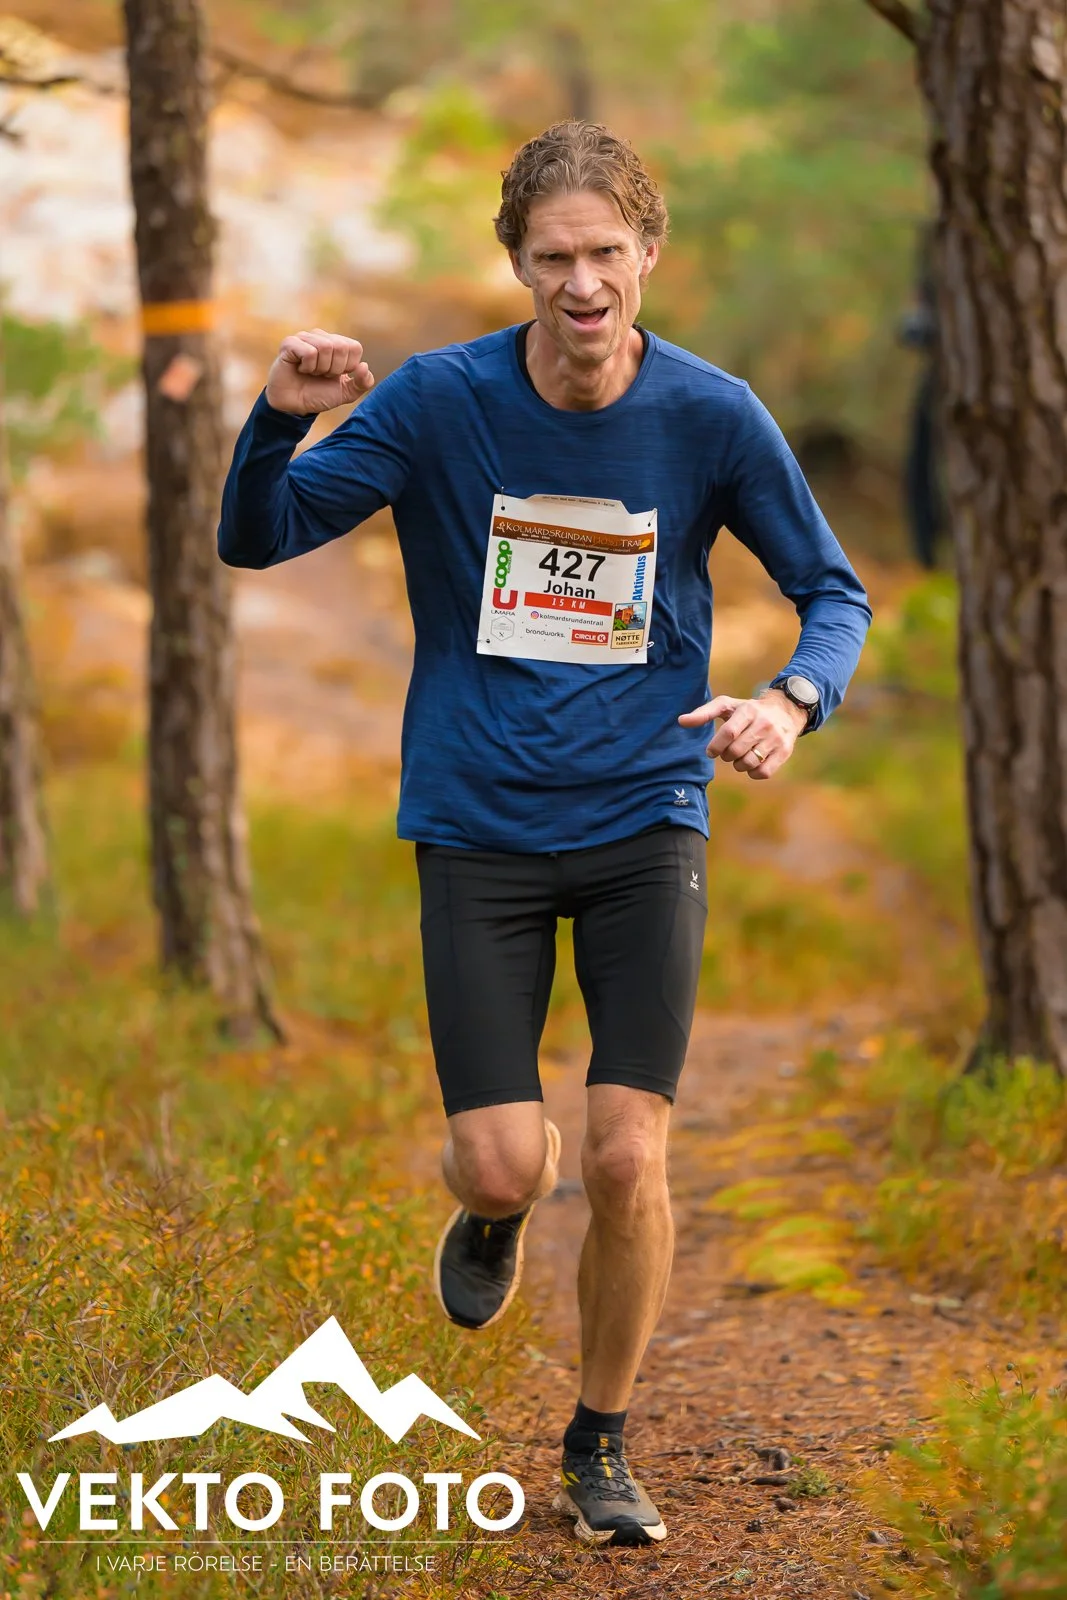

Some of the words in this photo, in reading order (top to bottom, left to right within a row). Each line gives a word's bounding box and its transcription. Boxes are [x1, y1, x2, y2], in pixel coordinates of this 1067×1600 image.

[495, 540, 512, 588] coop
[539, 548, 606, 582] 427
[632, 555, 646, 601] Aktivitus
[543, 580, 596, 600] Johan
[552, 597, 565, 607] 15
[571, 600, 586, 609] KM
[540, 613, 604, 626] kolmardsrundantrail
[574, 632, 597, 640] CIRCLE
